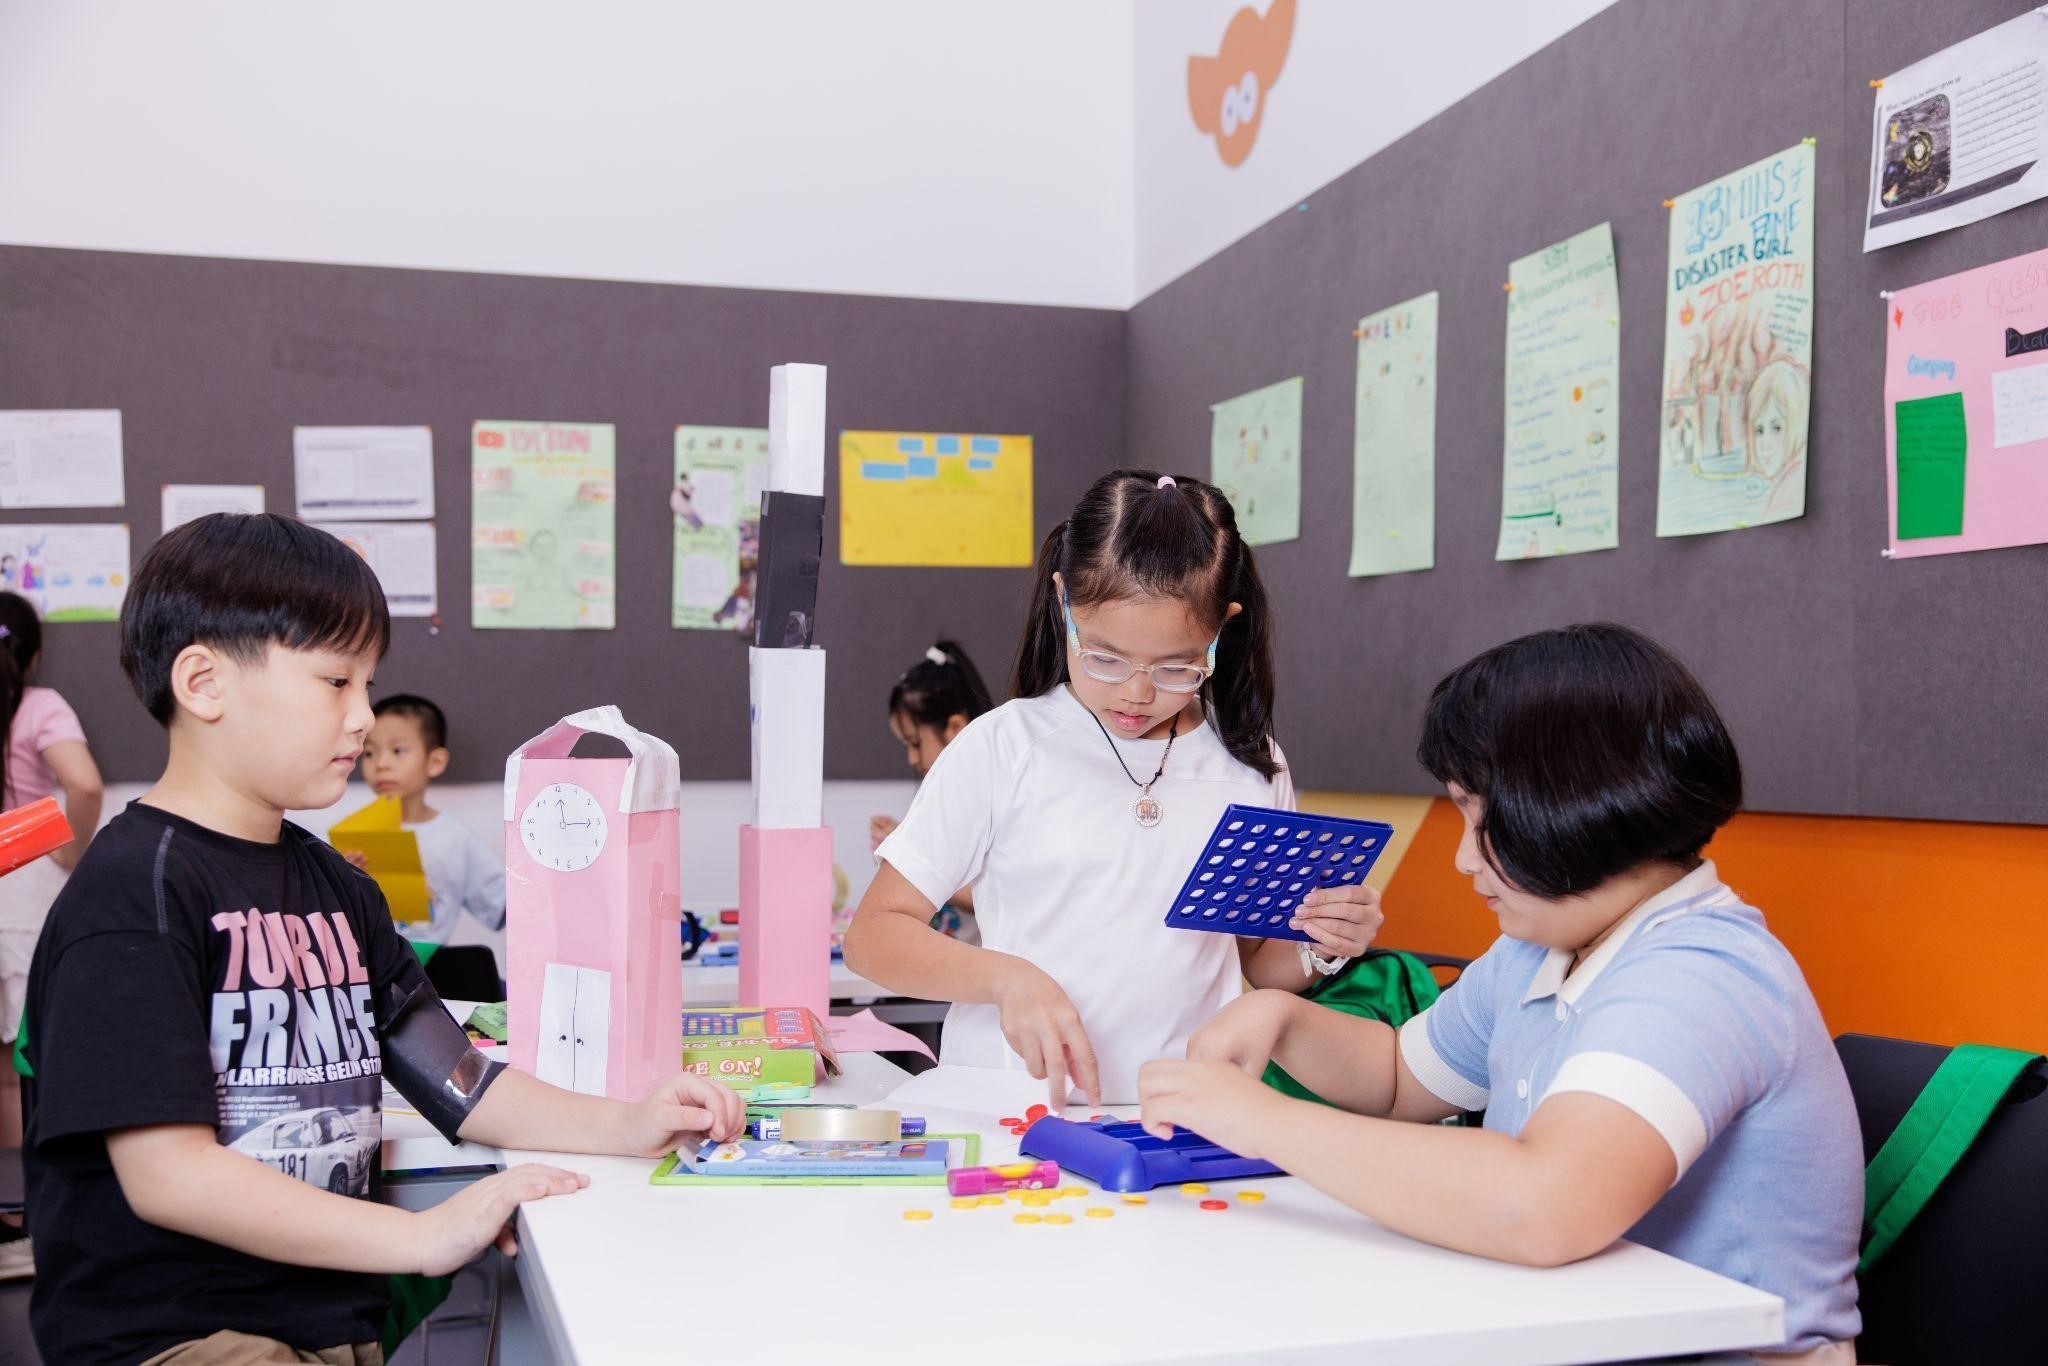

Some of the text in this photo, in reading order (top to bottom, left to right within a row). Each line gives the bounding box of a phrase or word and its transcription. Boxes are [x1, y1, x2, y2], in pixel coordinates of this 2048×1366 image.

[1725, 160, 1785, 227] MINS
[1675, 236, 1793, 291] DISASTER GIRL
[1698, 262, 1805, 321] ZOE ROTH
[1912, 295, 1962, 325] THE
[719, 1056, 762, 1077] ON!
[278, 1153, 308, 1181] 181
